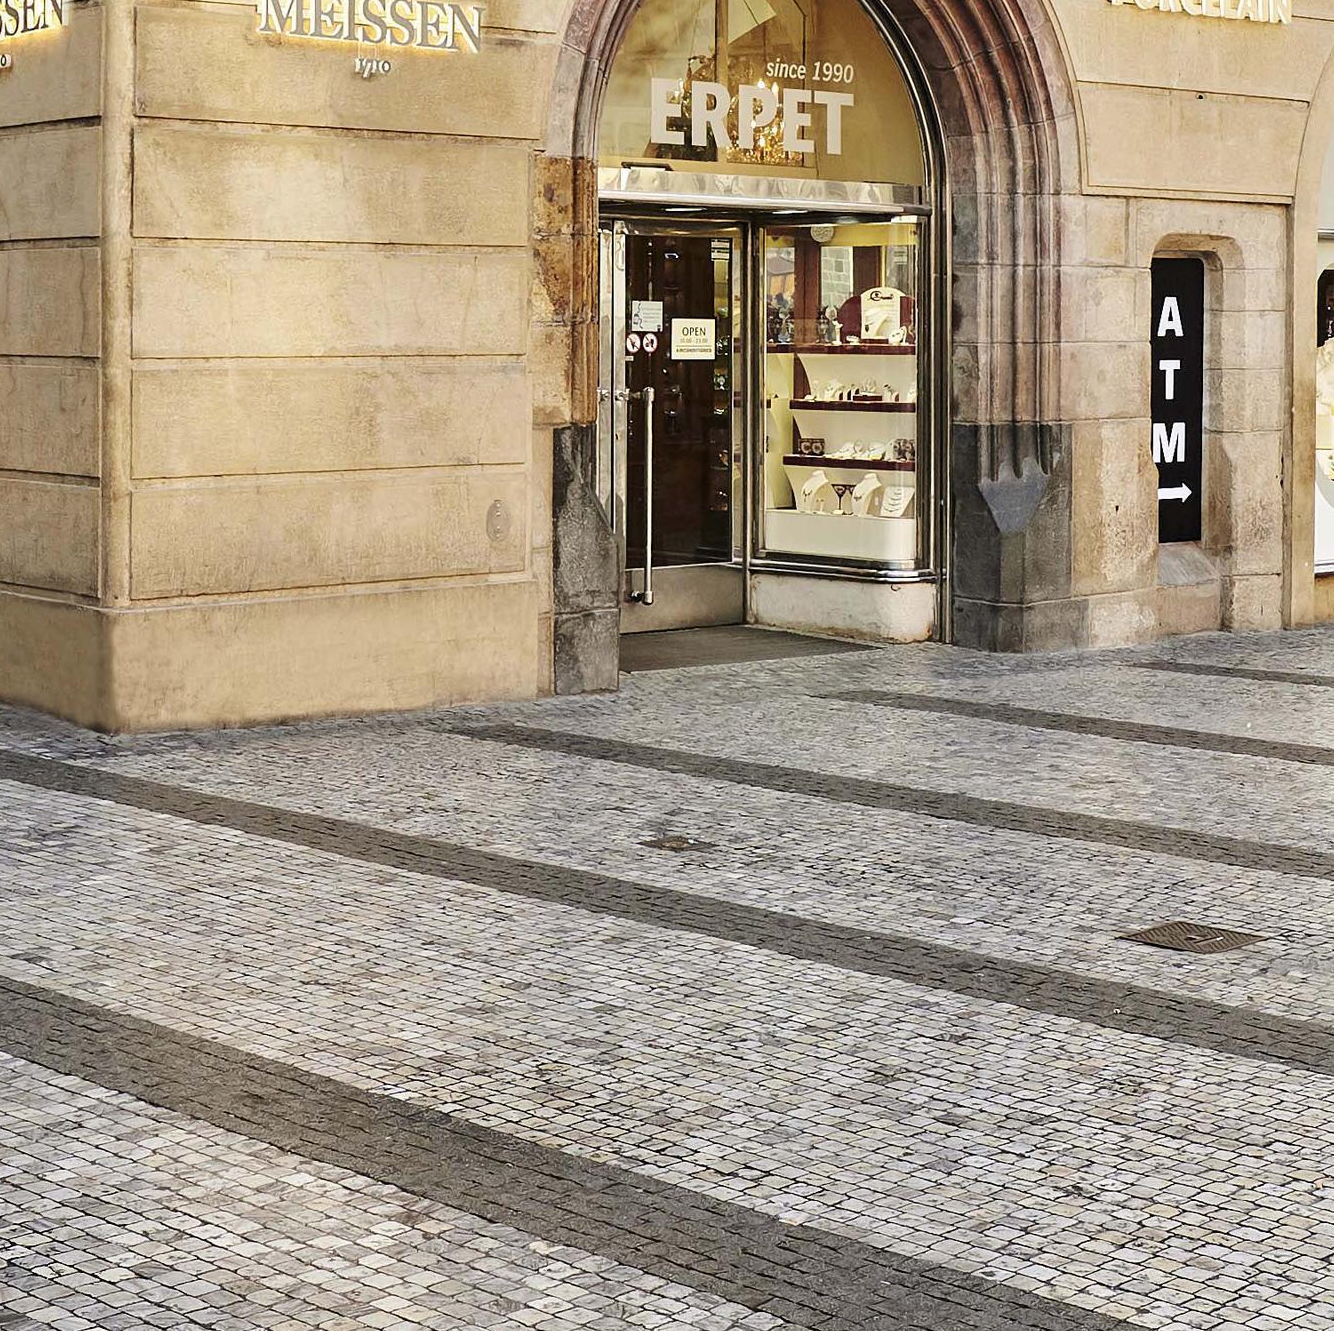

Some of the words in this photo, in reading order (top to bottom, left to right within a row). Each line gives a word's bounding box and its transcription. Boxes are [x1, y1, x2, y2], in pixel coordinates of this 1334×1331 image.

[355, 58, 392, 78] 1710
[766, 58, 807, 81] since
[812, 61, 855, 84] 1990
[650, 77, 855, 155] ERPET
[682, 327, 706, 336] OPEN
[1152, 296, 1185, 464] ATM
